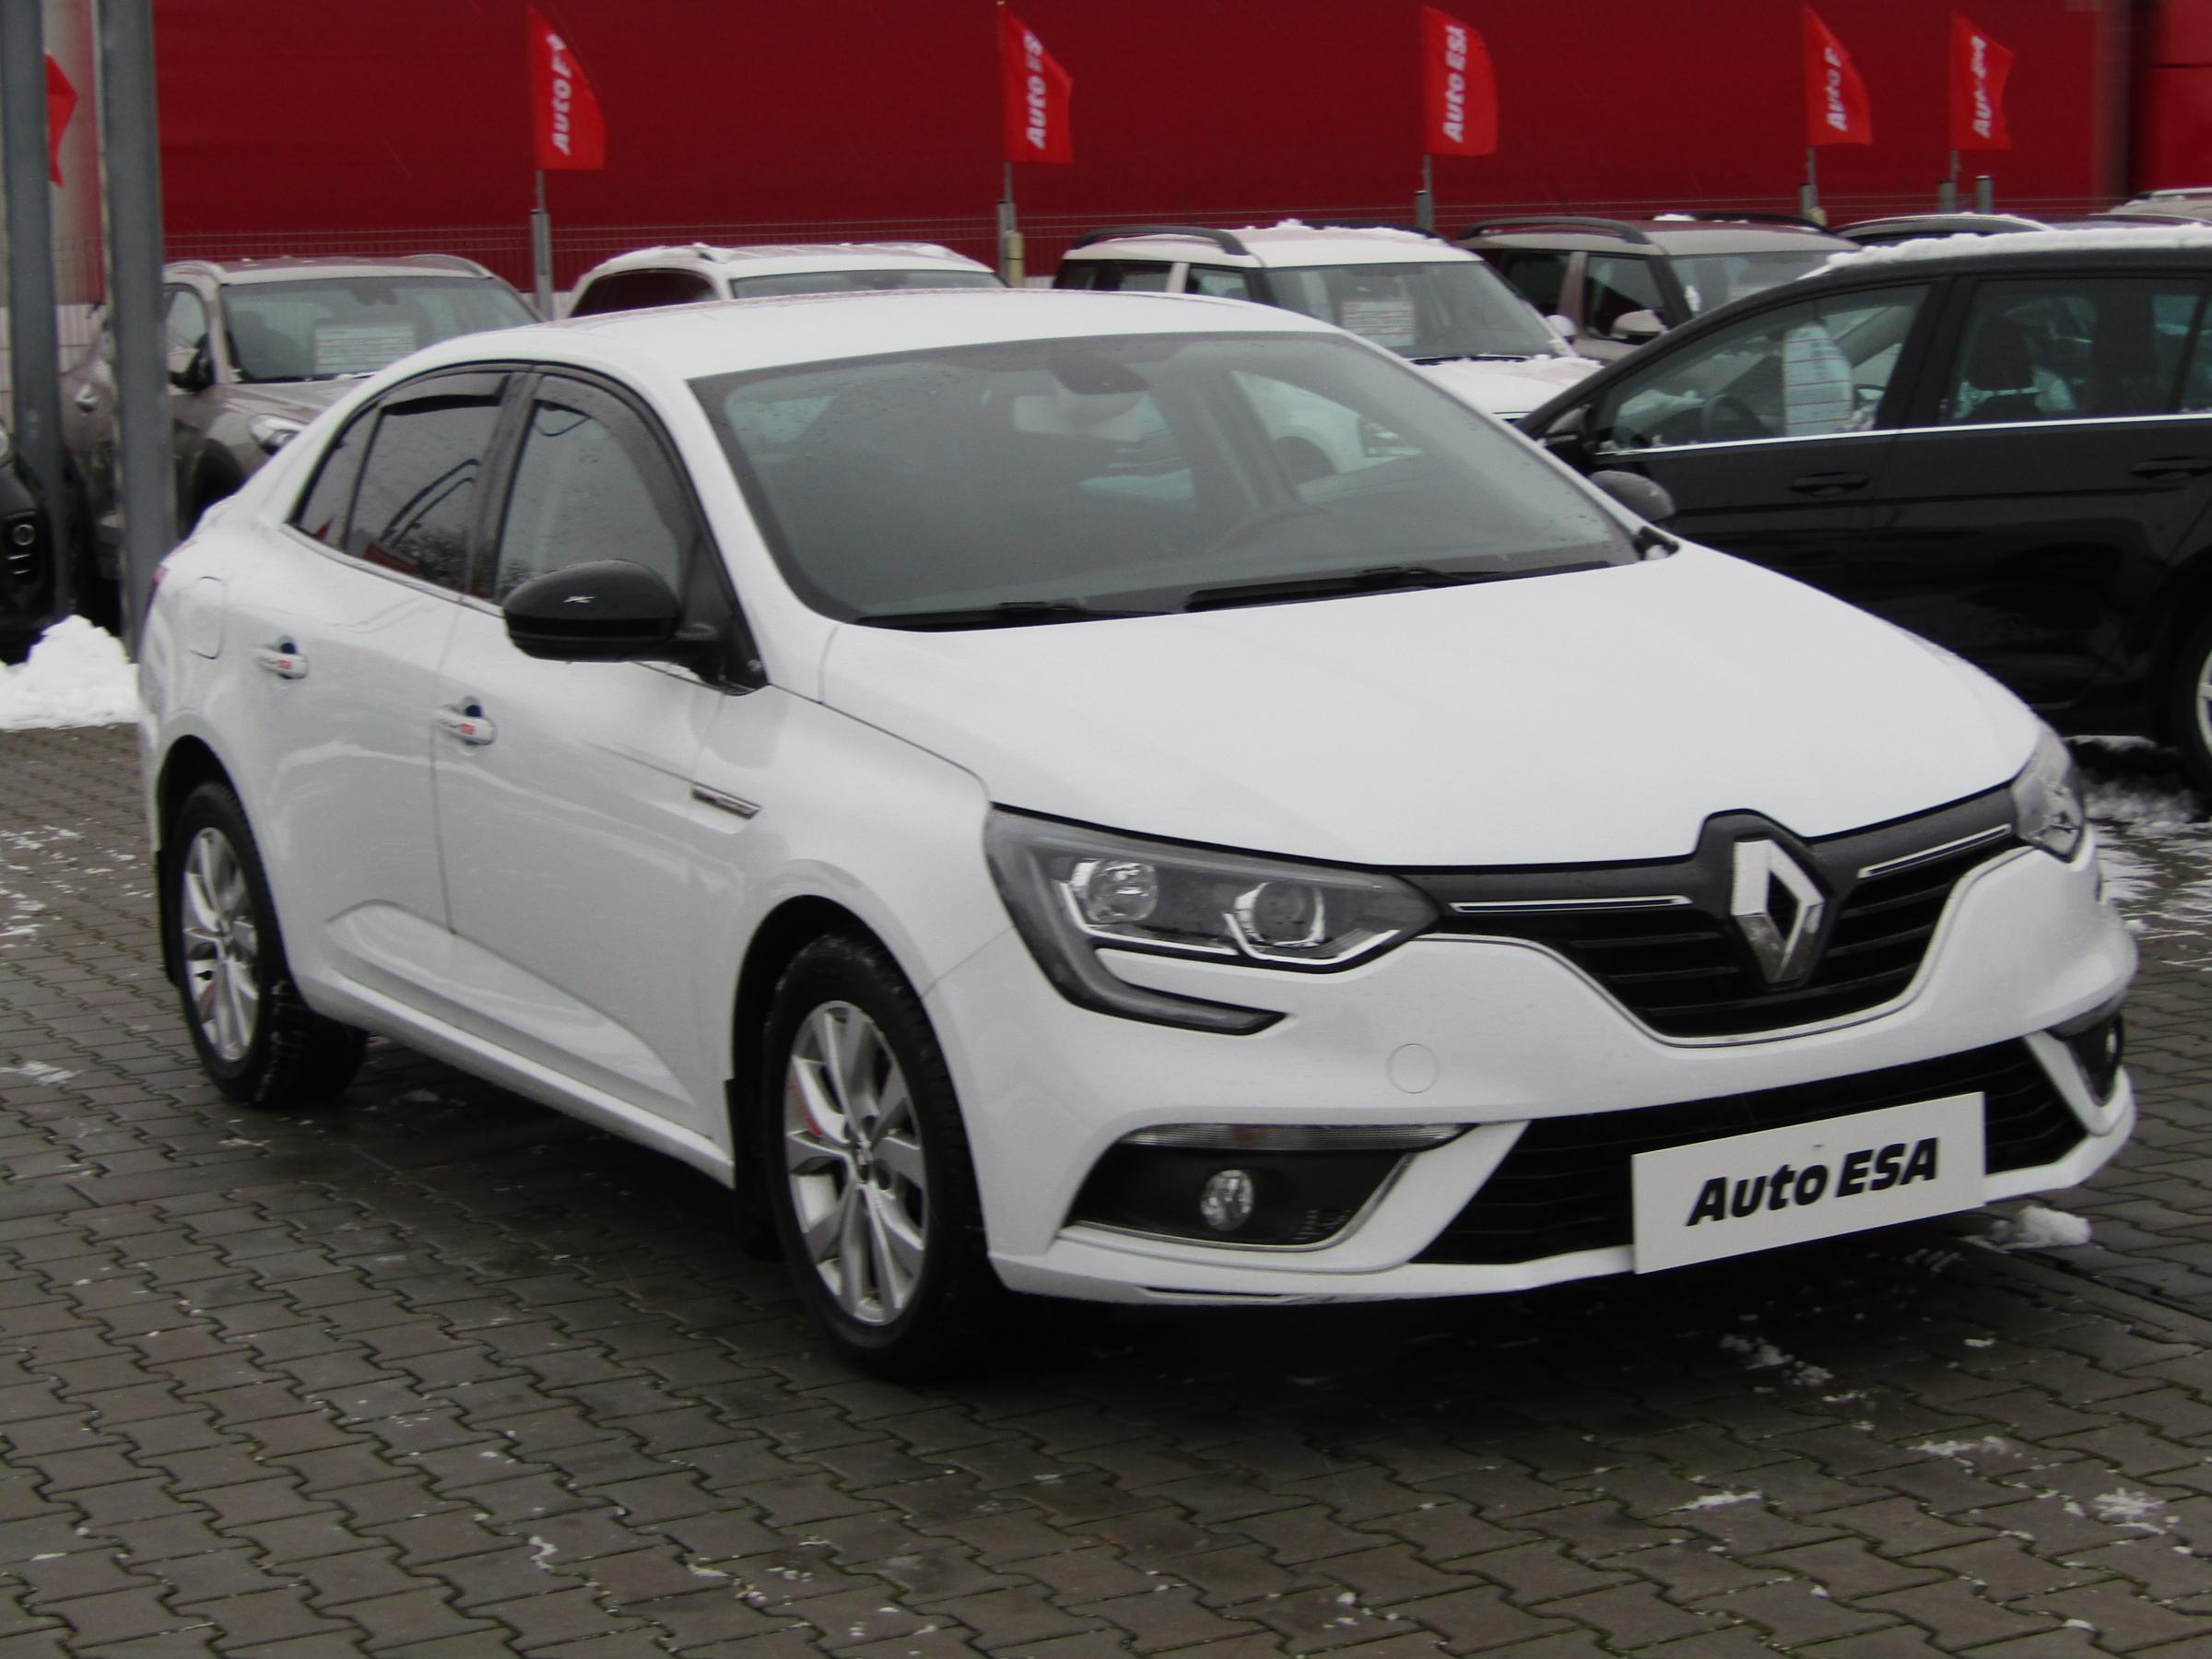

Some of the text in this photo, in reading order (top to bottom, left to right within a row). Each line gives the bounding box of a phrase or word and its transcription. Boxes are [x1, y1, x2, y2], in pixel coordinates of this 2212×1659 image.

[551, 77, 572, 156] Auto
[1026, 75, 1047, 149] Auto
[1442, 73, 1465, 143] Auto
[1824, 68, 1848, 131] Auto
[1685, 1136, 1939, 1227] Auto ESA
